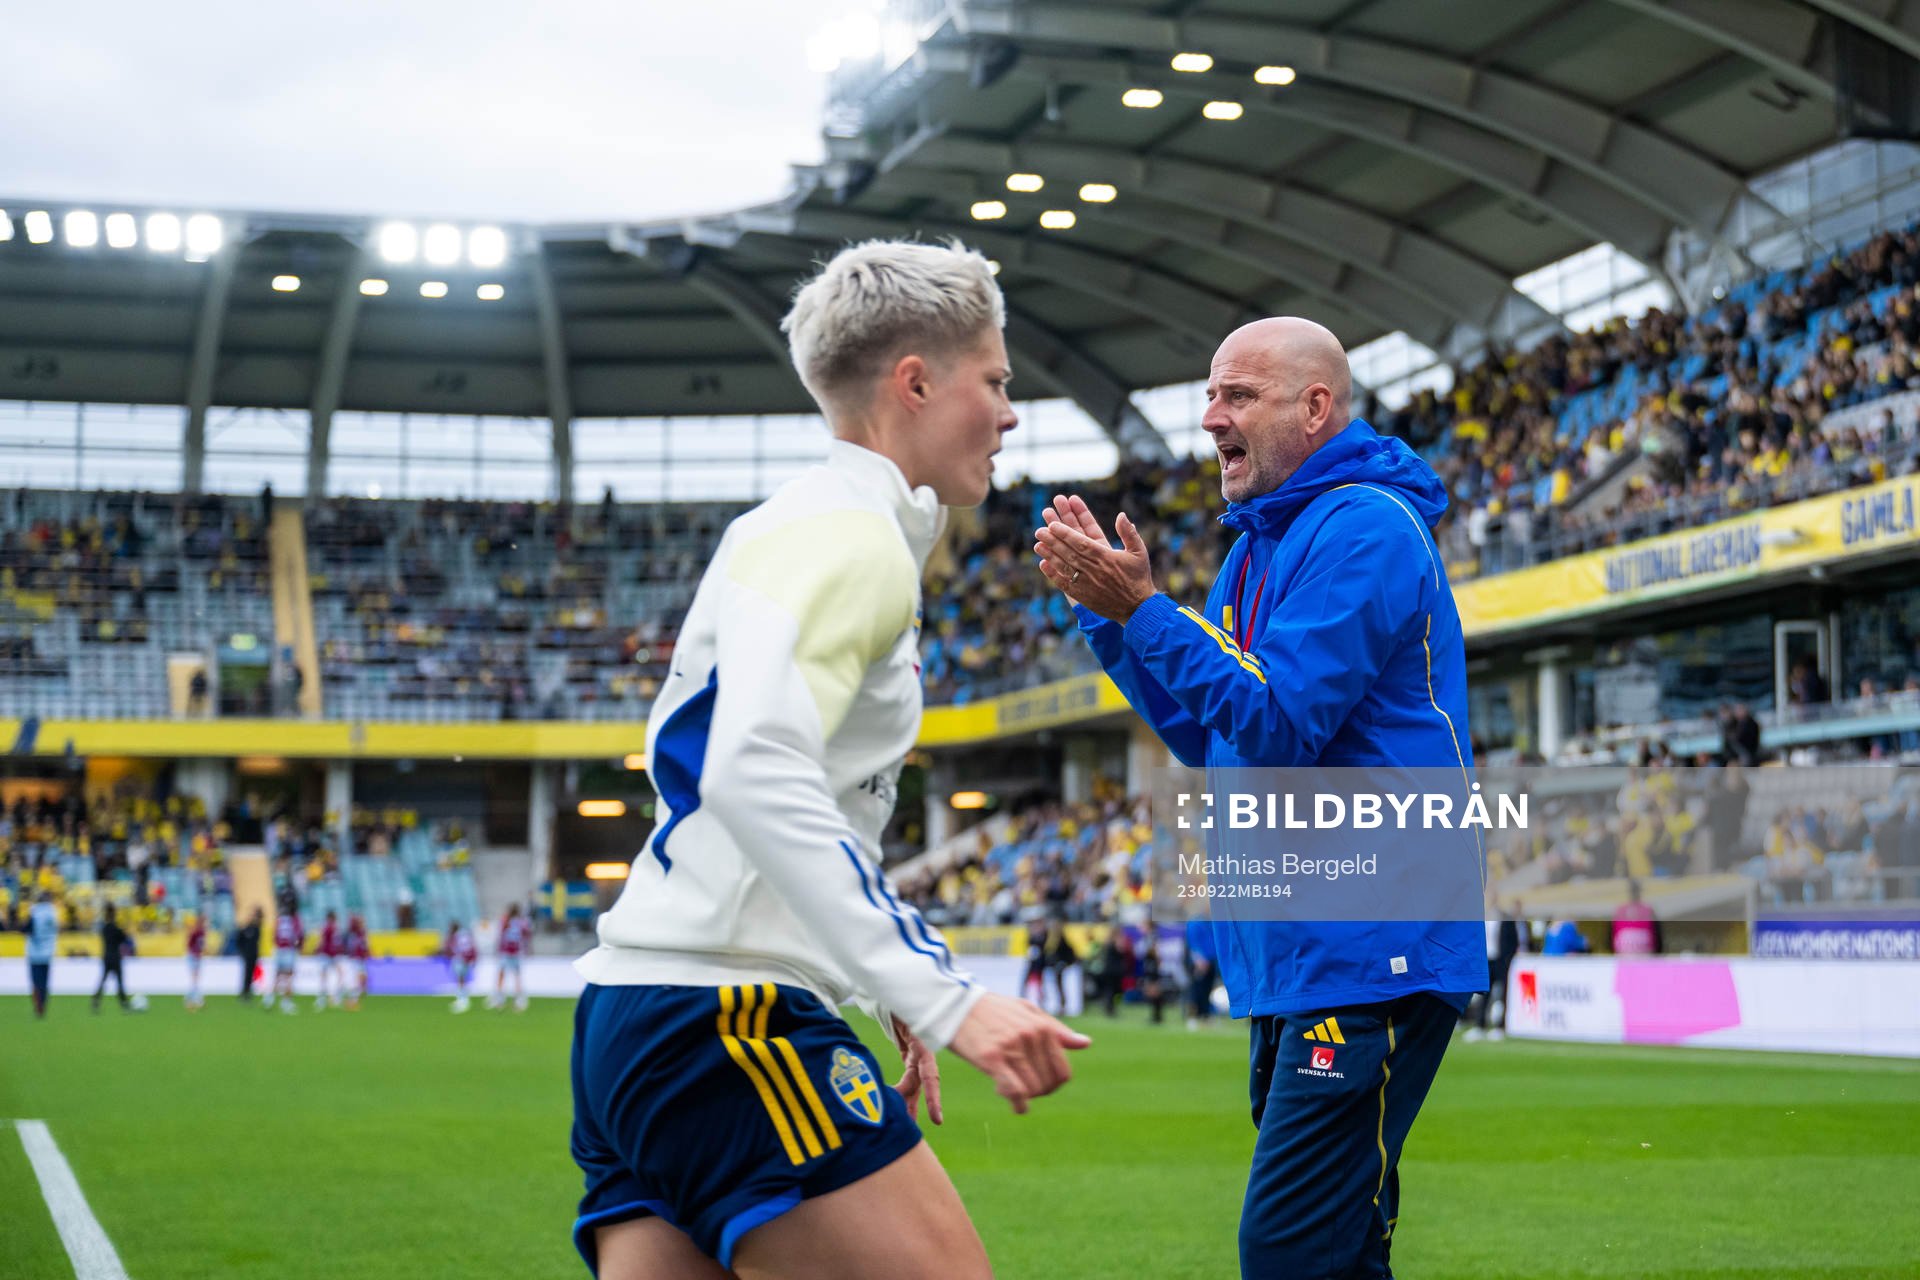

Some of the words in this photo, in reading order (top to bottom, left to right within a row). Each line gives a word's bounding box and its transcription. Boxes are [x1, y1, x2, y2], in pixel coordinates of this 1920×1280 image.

[1851, 928, 1915, 958] NATIONS
[1297, 1067, 1327, 1077] SVENSKA
[1327, 1071, 1345, 1079] SPEL
